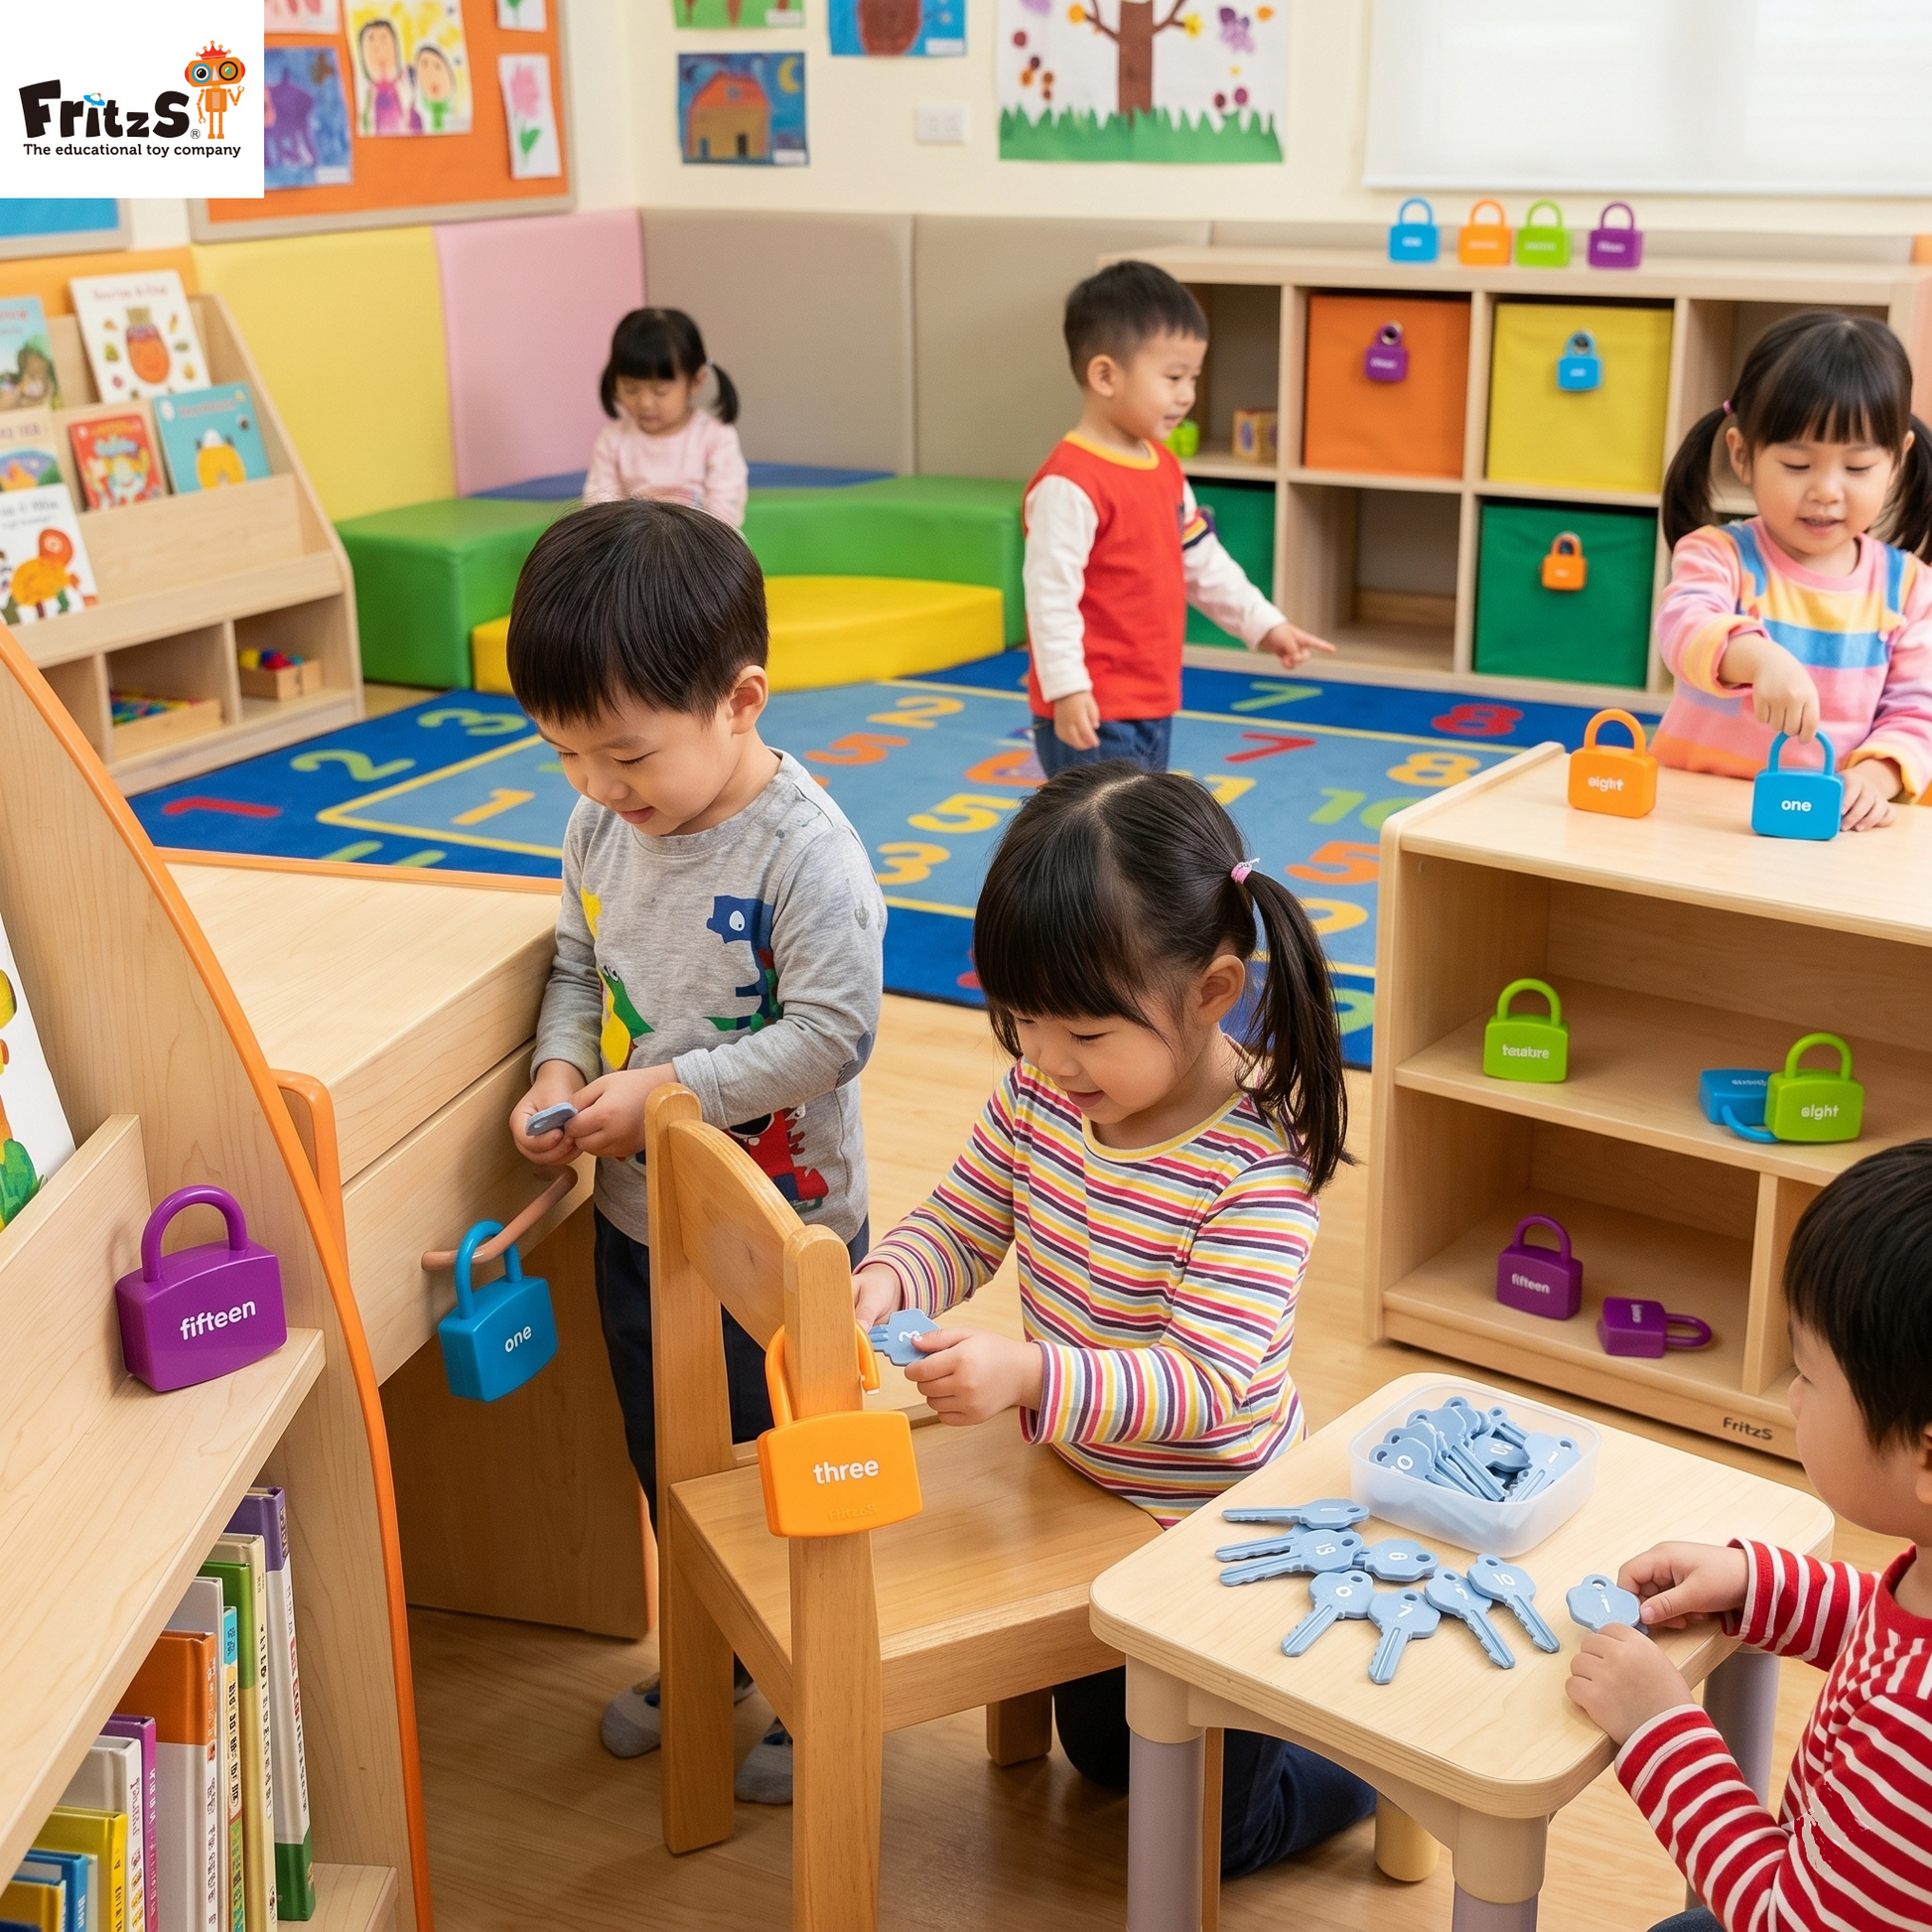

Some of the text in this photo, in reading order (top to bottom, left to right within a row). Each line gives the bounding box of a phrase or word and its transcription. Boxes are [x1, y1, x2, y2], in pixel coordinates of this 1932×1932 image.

[866, 695, 965, 729] 2
[1230, 681, 1323, 712] 7
[1431, 703, 1524, 737] 8
[803, 732, 910, 765] 5
[1223, 732, 1317, 763] 7
[1386, 752, 1482, 787] 8
[1587, 775, 1624, 792] eight
[451, 788, 536, 827] 1
[907, 792, 1024, 834] 5
[1780, 798, 1812, 812] one
[875, 841, 951, 886] 3
[1286, 840, 1380, 886] 5
[1511, 1272, 1551, 1295] fifteen
[179, 1299, 257, 1342] fifteen
[503, 1324, 532, 1354] one
[1723, 1416, 1774, 1442] FritzS
[812, 1459, 880, 1485] three
[1491, 1572, 1517, 1587] 10
